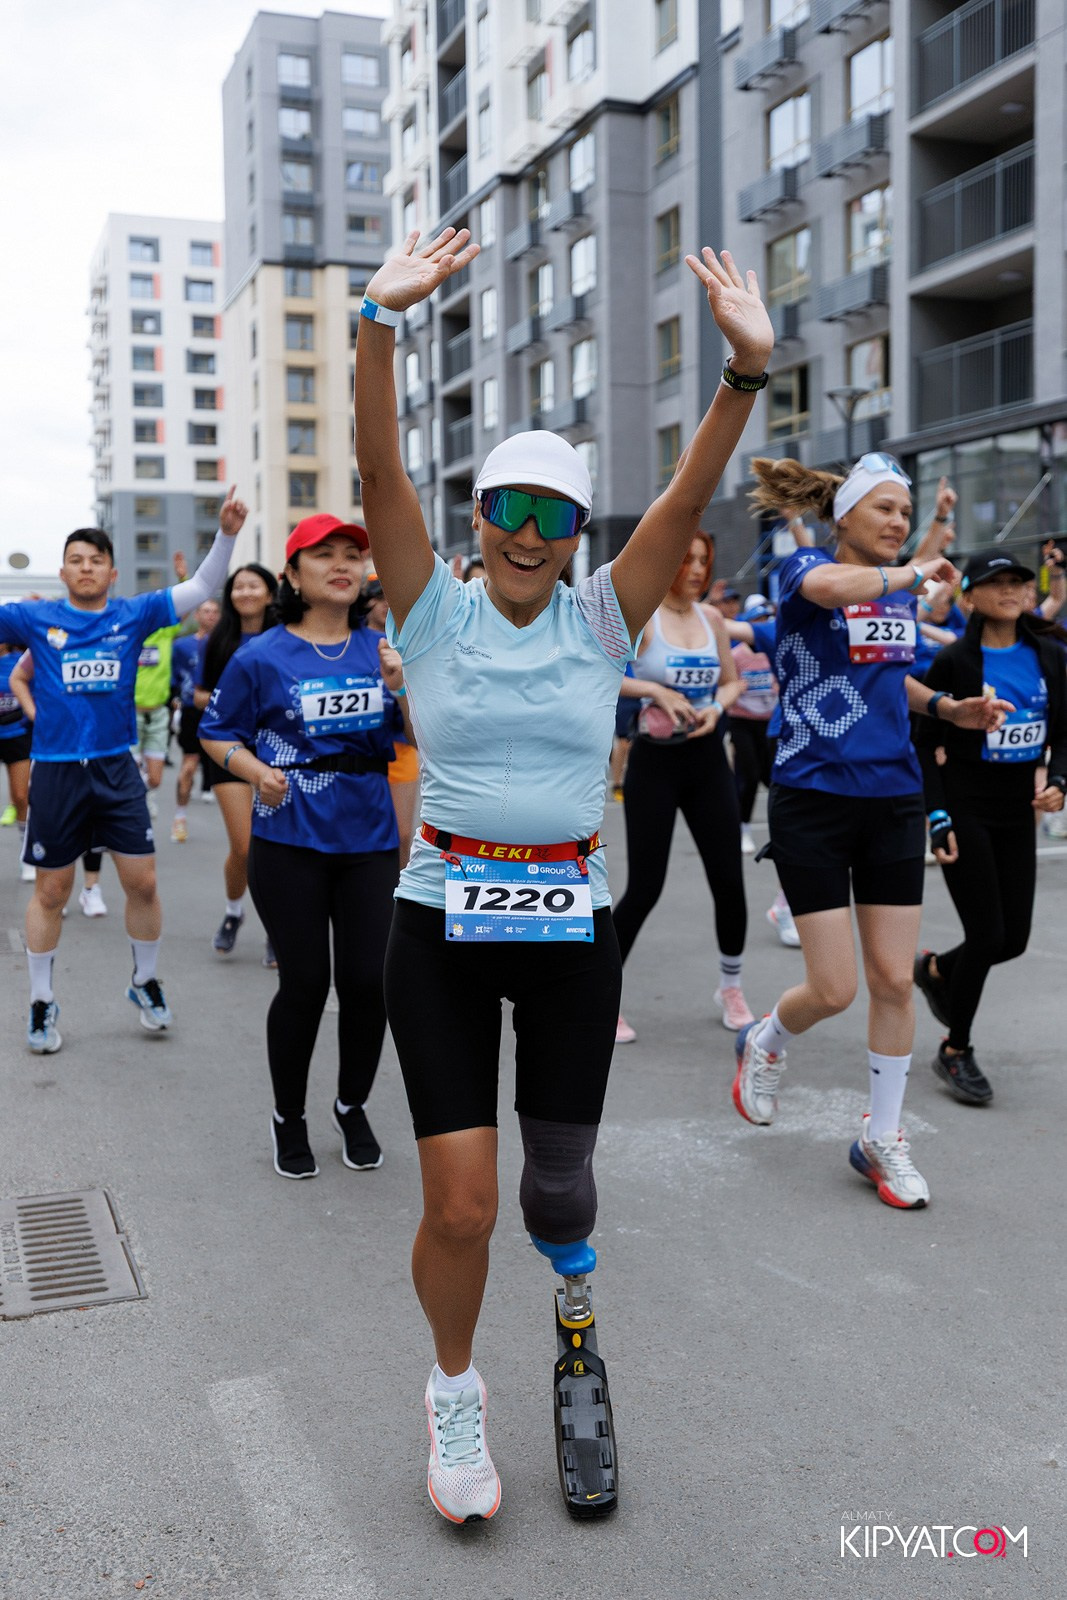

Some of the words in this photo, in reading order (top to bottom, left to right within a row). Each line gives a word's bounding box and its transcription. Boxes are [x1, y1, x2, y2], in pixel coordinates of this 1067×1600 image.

[865, 620, 906, 641] 232
[70, 662, 114, 679] 1093
[674, 669, 714, 685] 1338
[317, 692, 369, 717] 1321
[999, 725, 1042, 745] 1667
[478, 844, 532, 859] LEKI
[465, 864, 485, 873] KM
[464, 886, 575, 913] 1220
